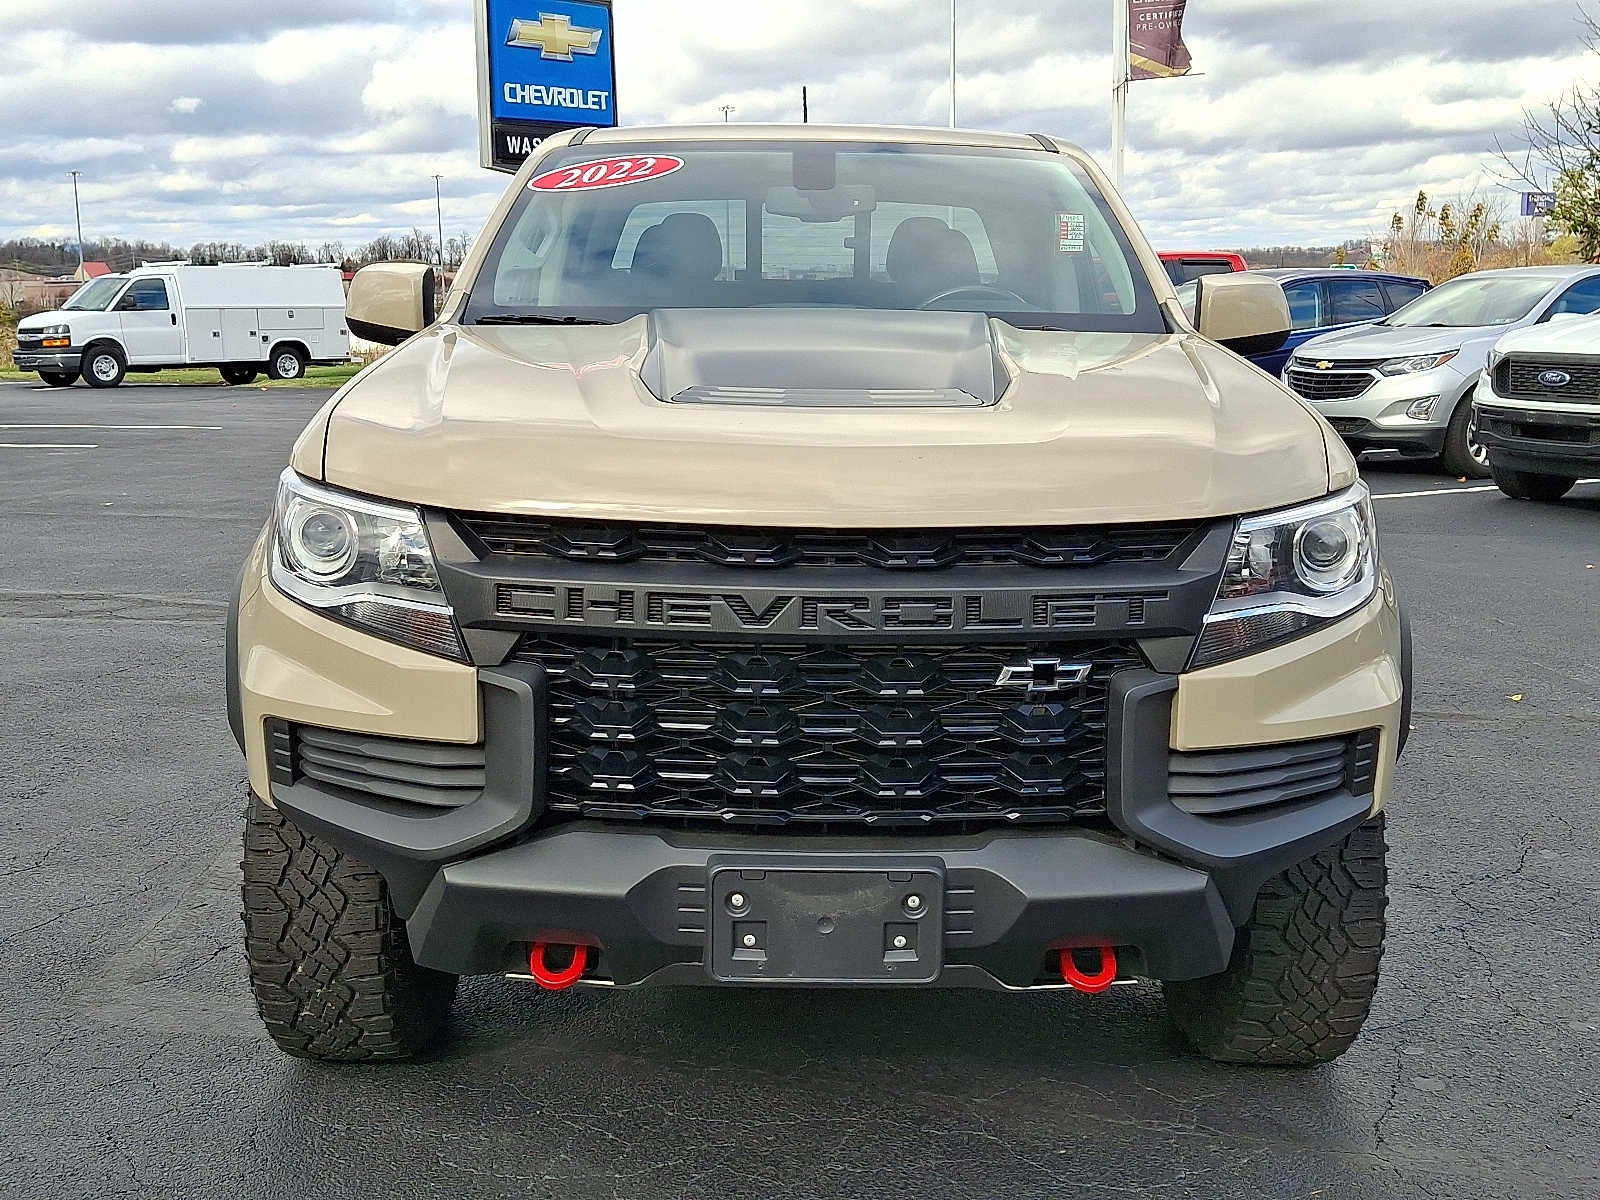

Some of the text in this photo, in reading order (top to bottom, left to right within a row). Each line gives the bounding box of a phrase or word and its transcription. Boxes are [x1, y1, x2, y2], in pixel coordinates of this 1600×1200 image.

[1139, 9, 1183, 21] CERTIFIED
[504, 83, 609, 110] CHEVROLET
[554, 157, 656, 189] 2022
[1542, 372, 1562, 383] Ford
[495, 583, 1169, 630] CHEVROLET
